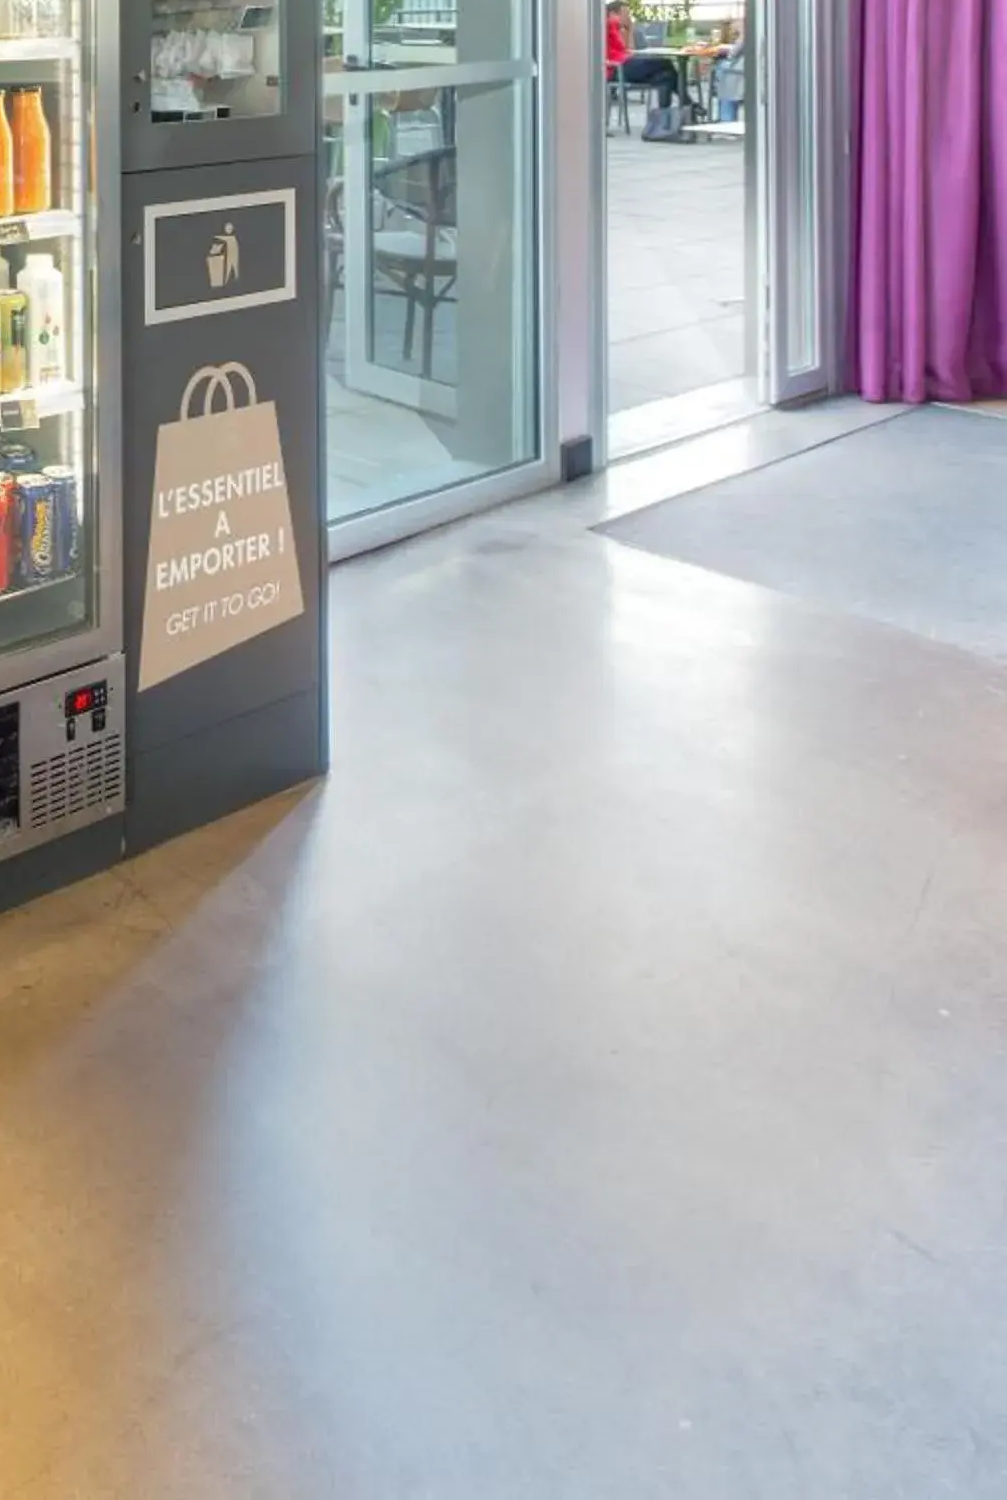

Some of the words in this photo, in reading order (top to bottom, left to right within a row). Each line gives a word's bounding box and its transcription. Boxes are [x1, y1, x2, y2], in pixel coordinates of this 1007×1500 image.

[158, 461, 284, 519] L'ESSENTIEL
[215, 510, 231, 538] A
[155, 532, 271, 591] EMPORTER
[166, 606, 199, 636] GET
[204, 599, 218, 623] IT
[219, 591, 244, 617] TO
[247, 580, 282, 611] GO!
